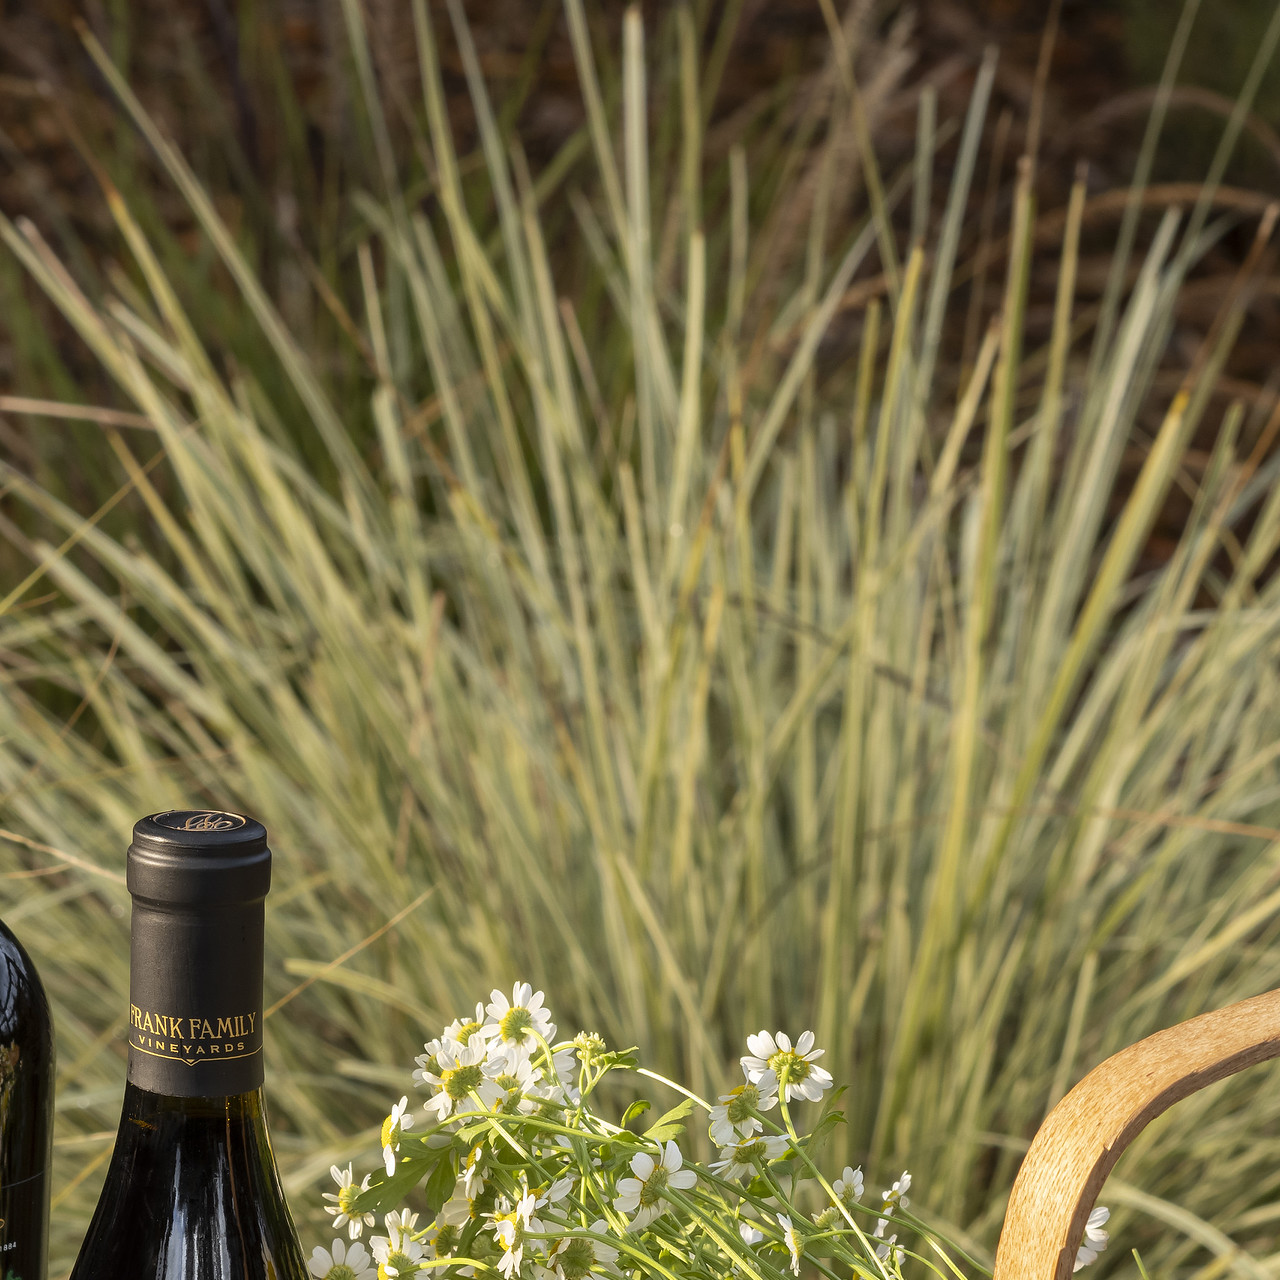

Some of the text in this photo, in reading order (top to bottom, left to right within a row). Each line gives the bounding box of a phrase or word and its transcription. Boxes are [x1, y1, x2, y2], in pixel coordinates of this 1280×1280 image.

[130, 1003, 257, 1040] FRANK FAMILY
[138, 1034, 245, 1054] VINEYARDS
[0, 1241, 17, 1253] 1884
